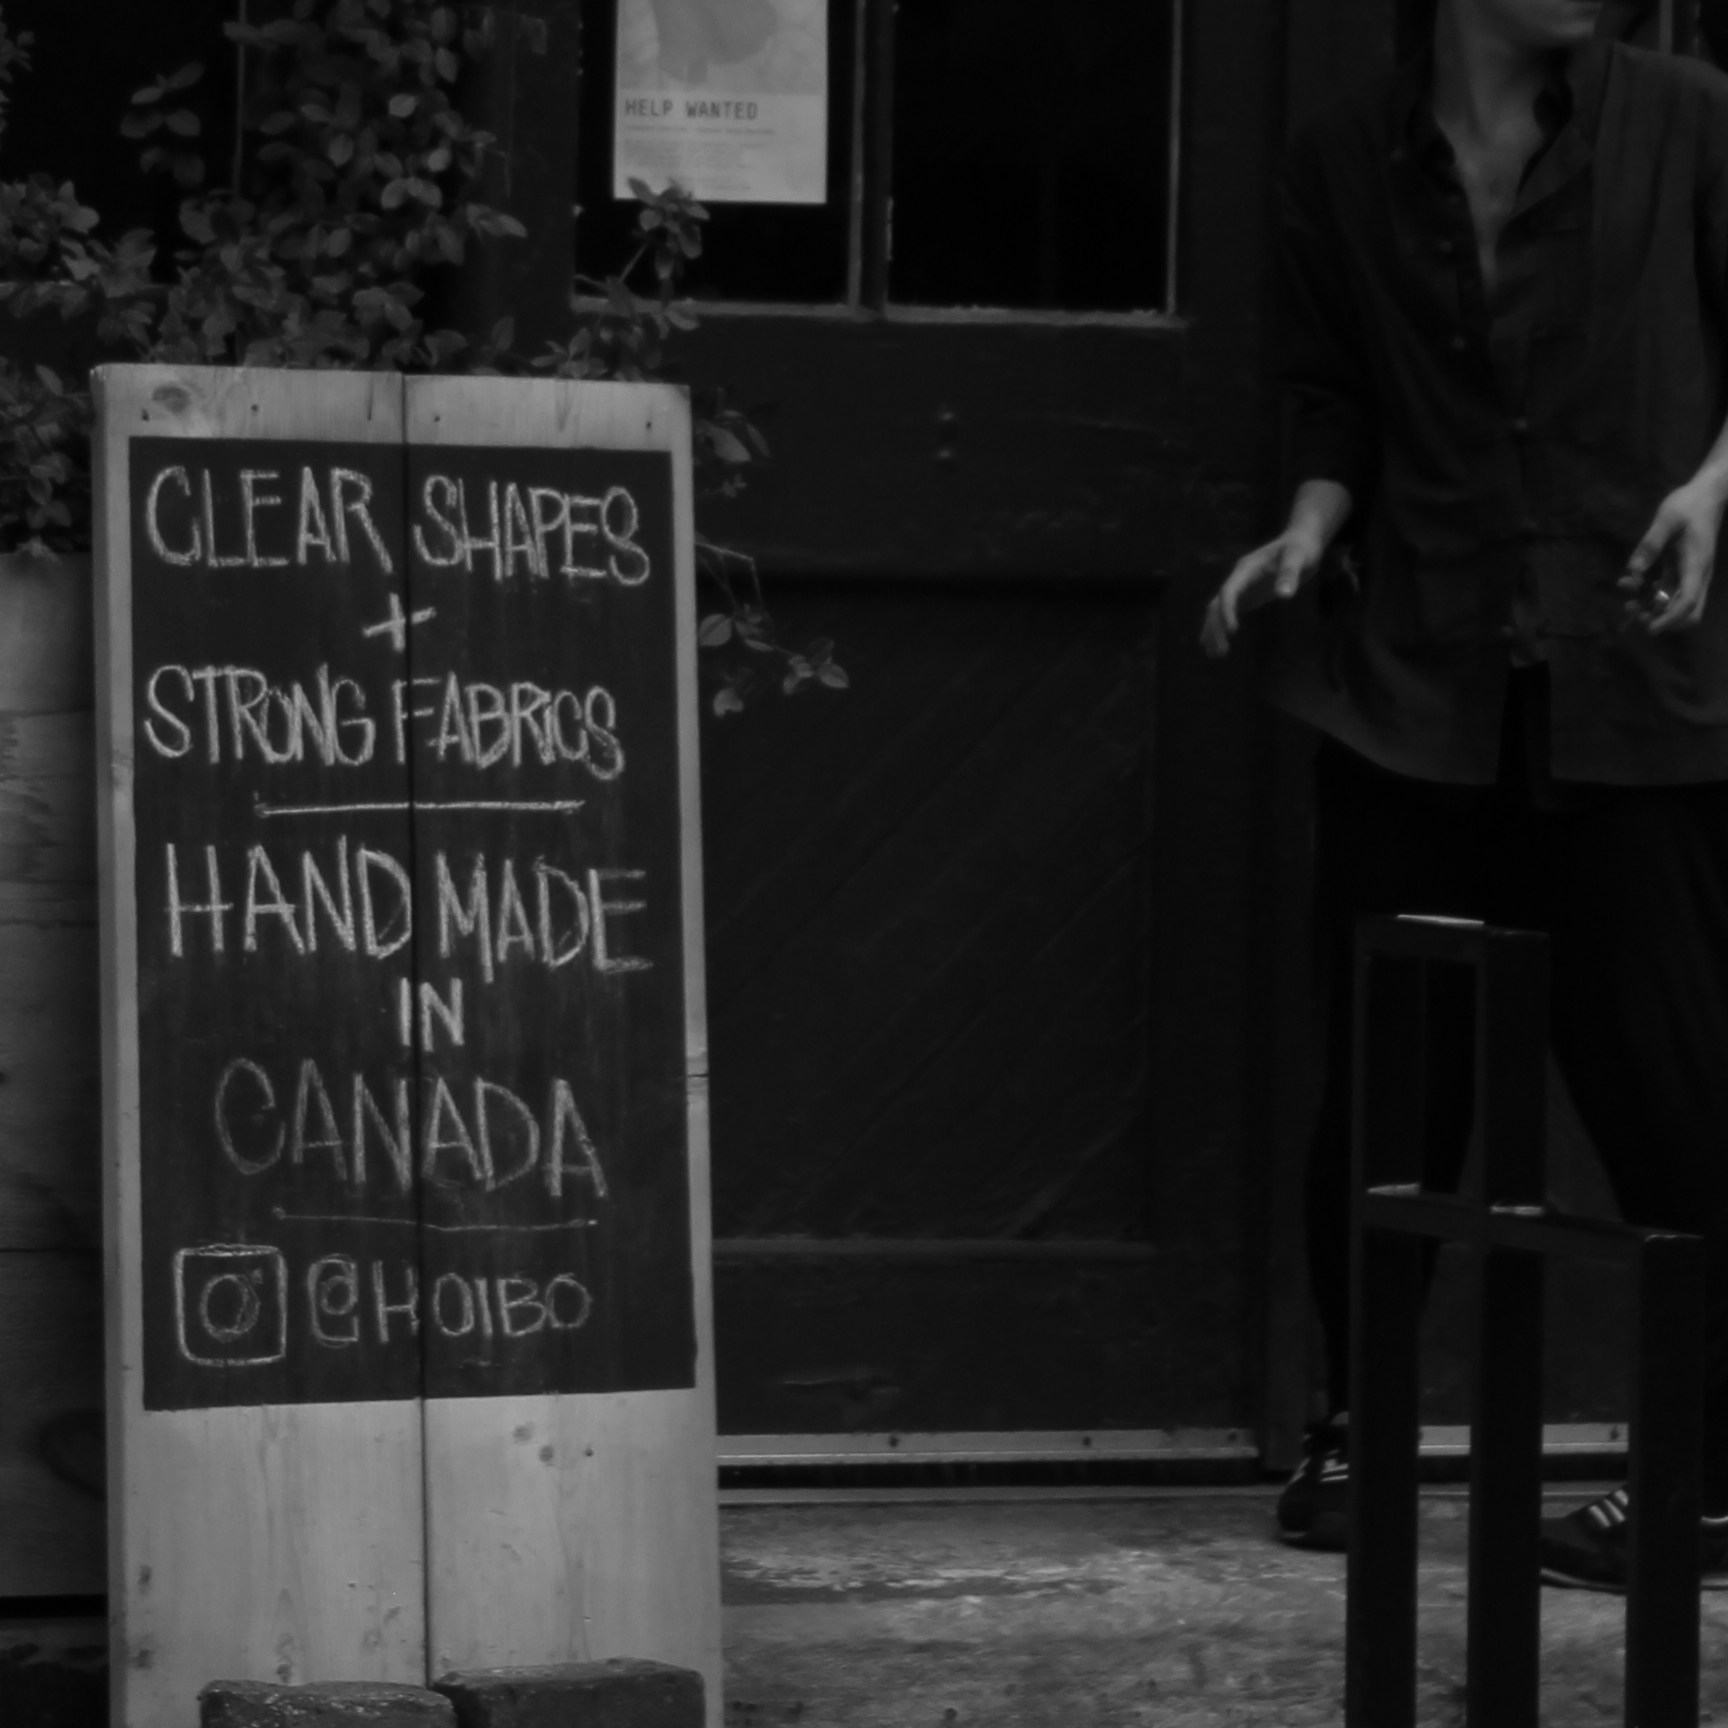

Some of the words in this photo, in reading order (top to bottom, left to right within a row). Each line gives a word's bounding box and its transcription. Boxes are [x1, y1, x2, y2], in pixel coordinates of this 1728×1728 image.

[625, 98, 673, 117] HELP
[685, 101, 759, 120] WANTED
[145, 465, 394, 574] CLEAR
[414, 475, 651, 586] SHAPES
[144, 662, 375, 767] STRONG
[391, 672, 626, 781] FABRICS
[165, 835, 414, 960] HAND
[435, 850, 655, 984] MADE
[399, 977, 465, 1053] IN
[214, 1057, 610, 1200] CANADA
[308, 1253, 593, 1348] @HOIBO
